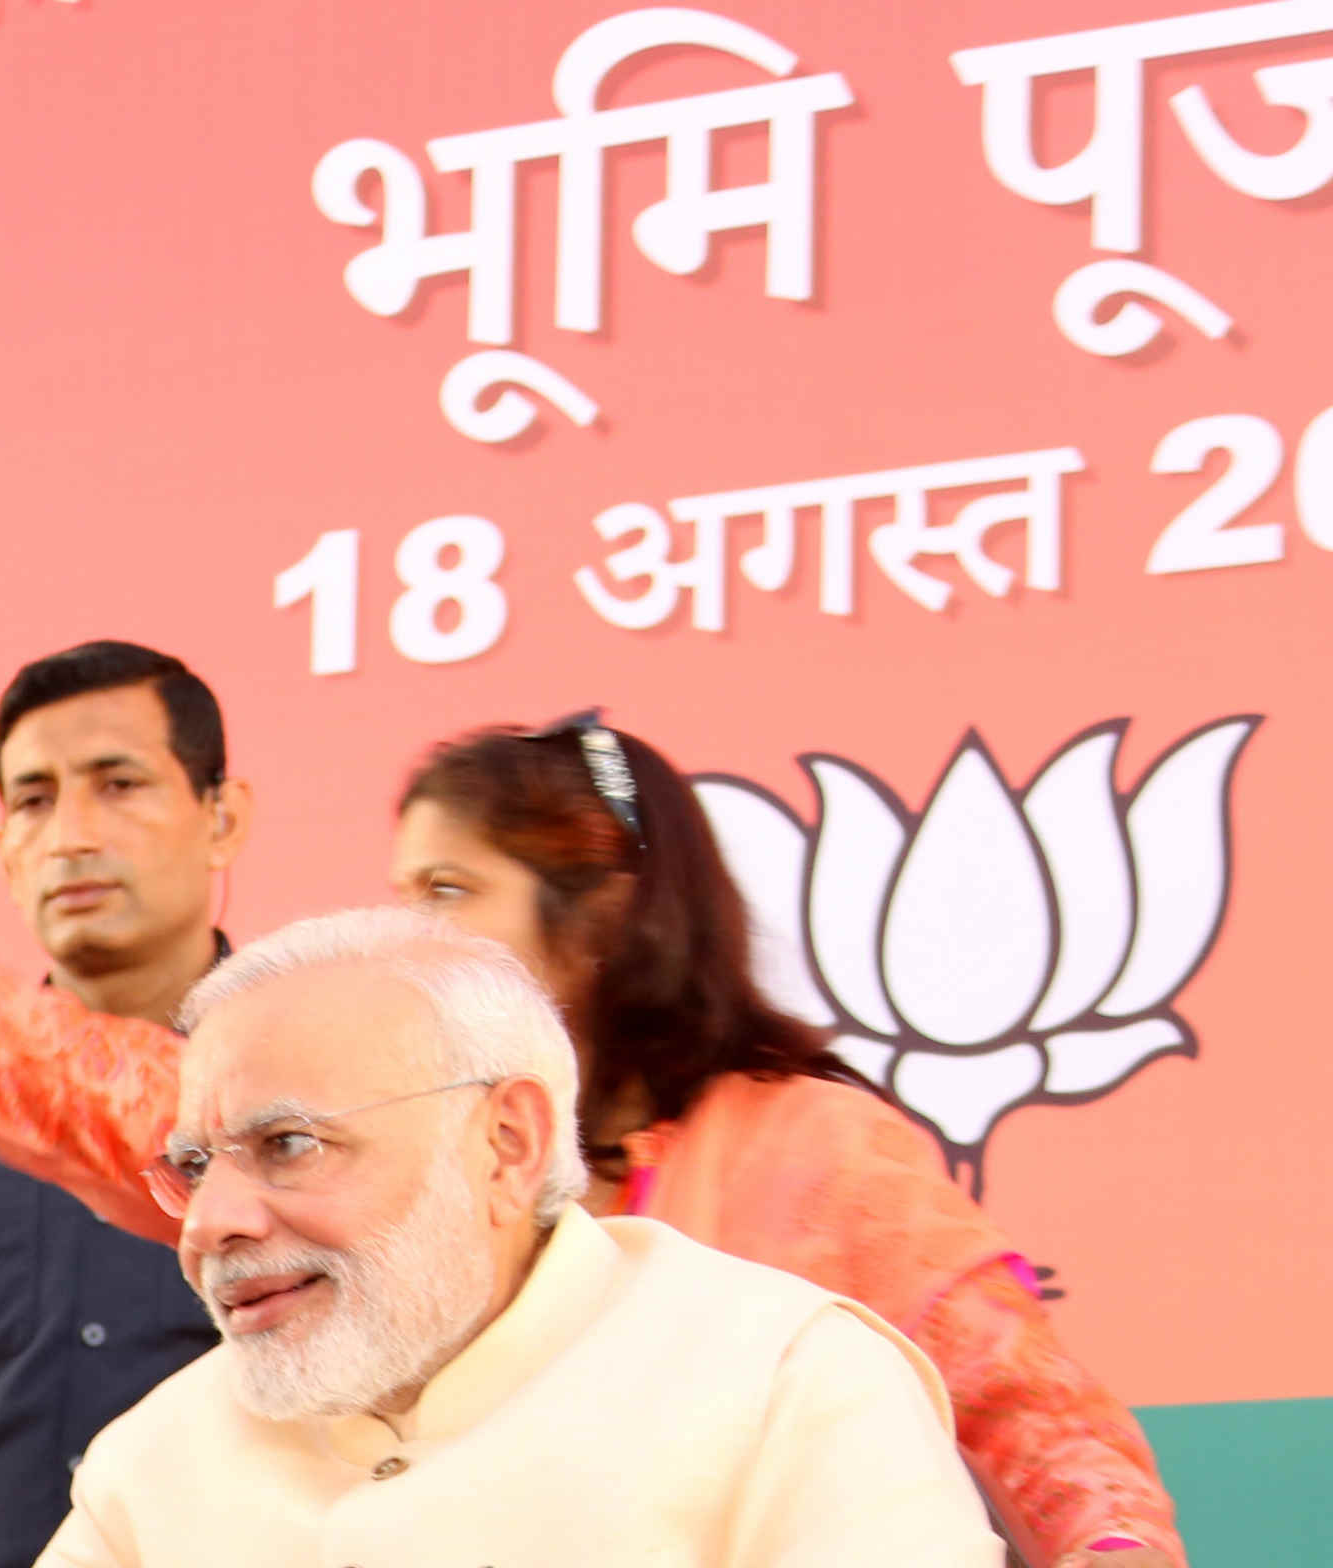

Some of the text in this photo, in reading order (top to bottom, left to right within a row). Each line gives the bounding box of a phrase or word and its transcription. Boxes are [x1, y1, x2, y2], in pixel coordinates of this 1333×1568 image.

[311, 7, 853, 444] भूमि
[273, 514, 509, 676] 18
[573, 446, 1086, 632] अगस्त
